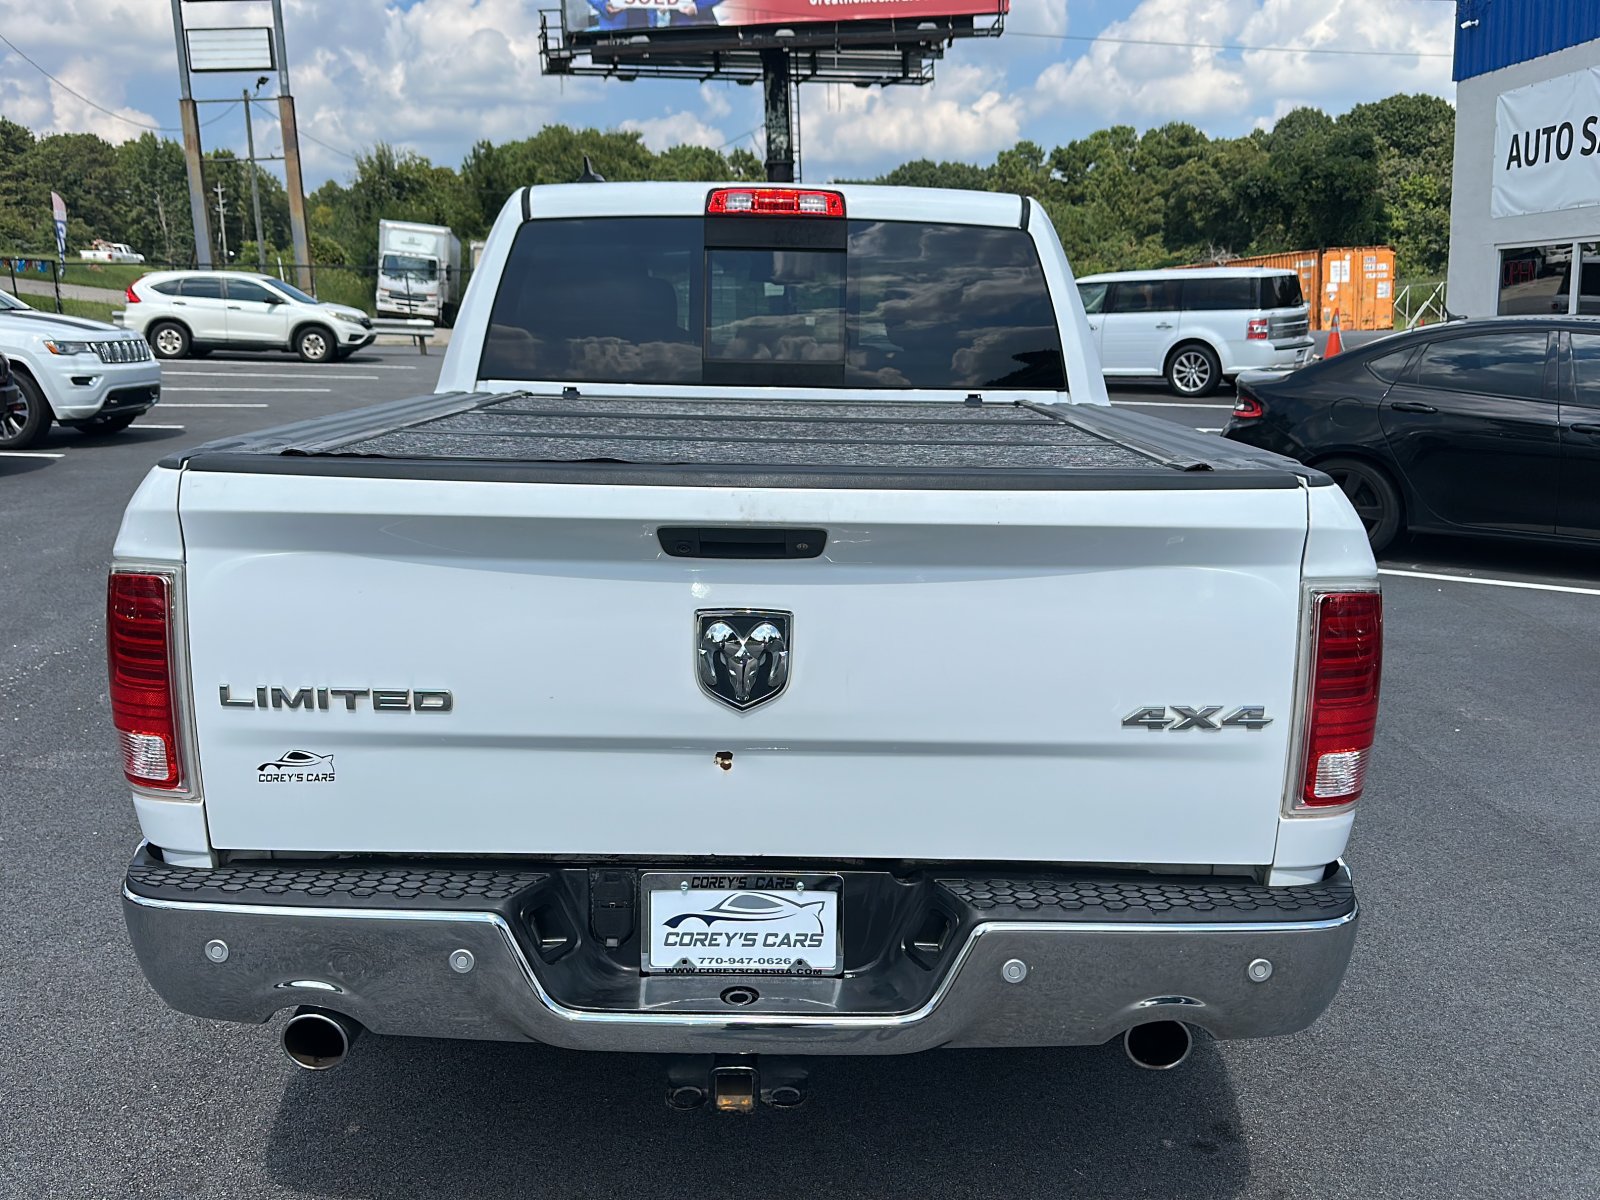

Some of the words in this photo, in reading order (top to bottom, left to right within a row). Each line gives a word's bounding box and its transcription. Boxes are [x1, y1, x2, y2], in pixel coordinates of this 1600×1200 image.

[1506, 121, 1574, 171] AUTO
[1580, 115, 1600, 156] S
[219, 684, 454, 713] LIMITED
[1122, 705, 1274, 730] 4X4
[258, 773, 303, 783] COREY'S
[306, 773, 335, 782] CARS
[691, 876, 748, 889] COREY'S
[756, 876, 796, 889] CARS
[663, 932, 758, 947] COREY'S
[762, 932, 825, 948] CARS
[698, 957, 792, 965] 770-947-0626
